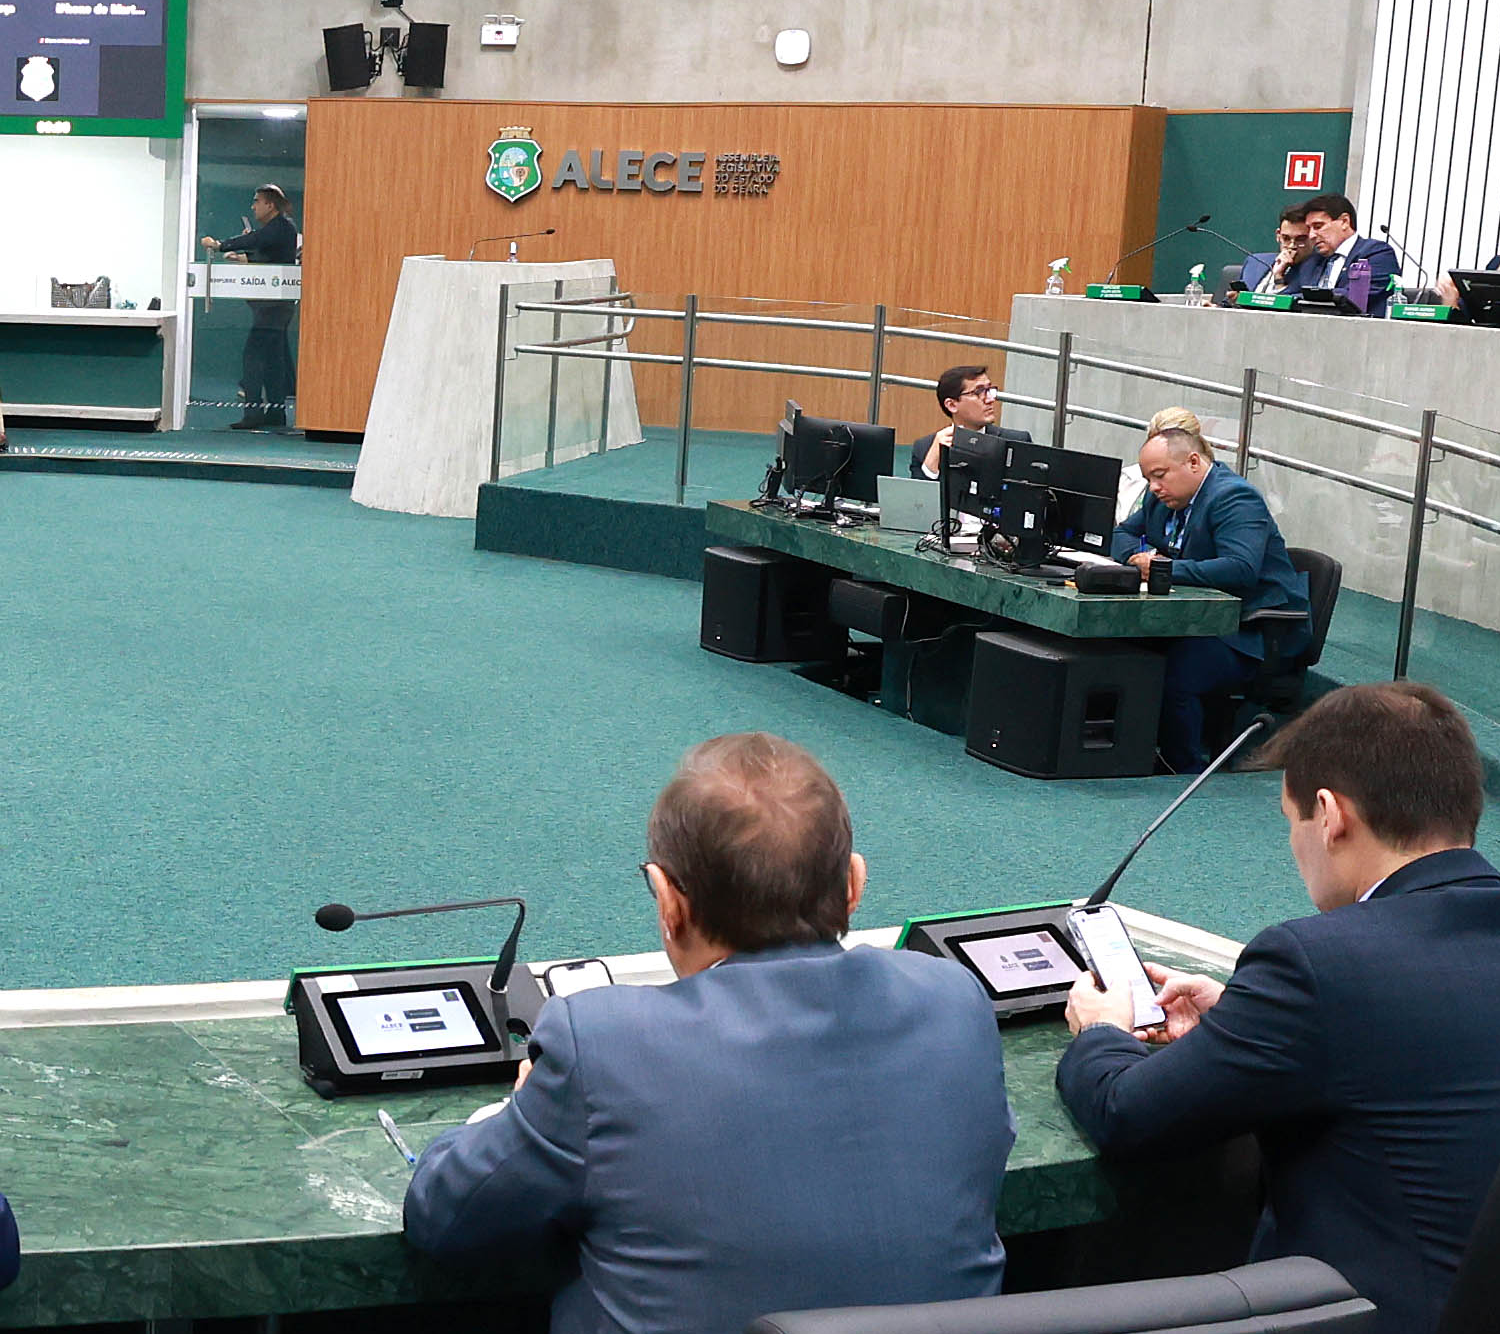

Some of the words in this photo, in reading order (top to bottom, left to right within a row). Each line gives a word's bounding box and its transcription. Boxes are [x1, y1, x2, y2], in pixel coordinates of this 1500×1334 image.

[715, 153, 780, 163] ASSEMBLEIA
[551, 148, 706, 193] ALECE
[715, 163, 780, 173] LEGISLATIVA
[1293, 160, 1316, 182] H
[715, 173, 729, 183] DO
[733, 173, 774, 184] ESTADO
[714, 184, 728, 193] DO
[281, 278, 302, 287] ALEC
